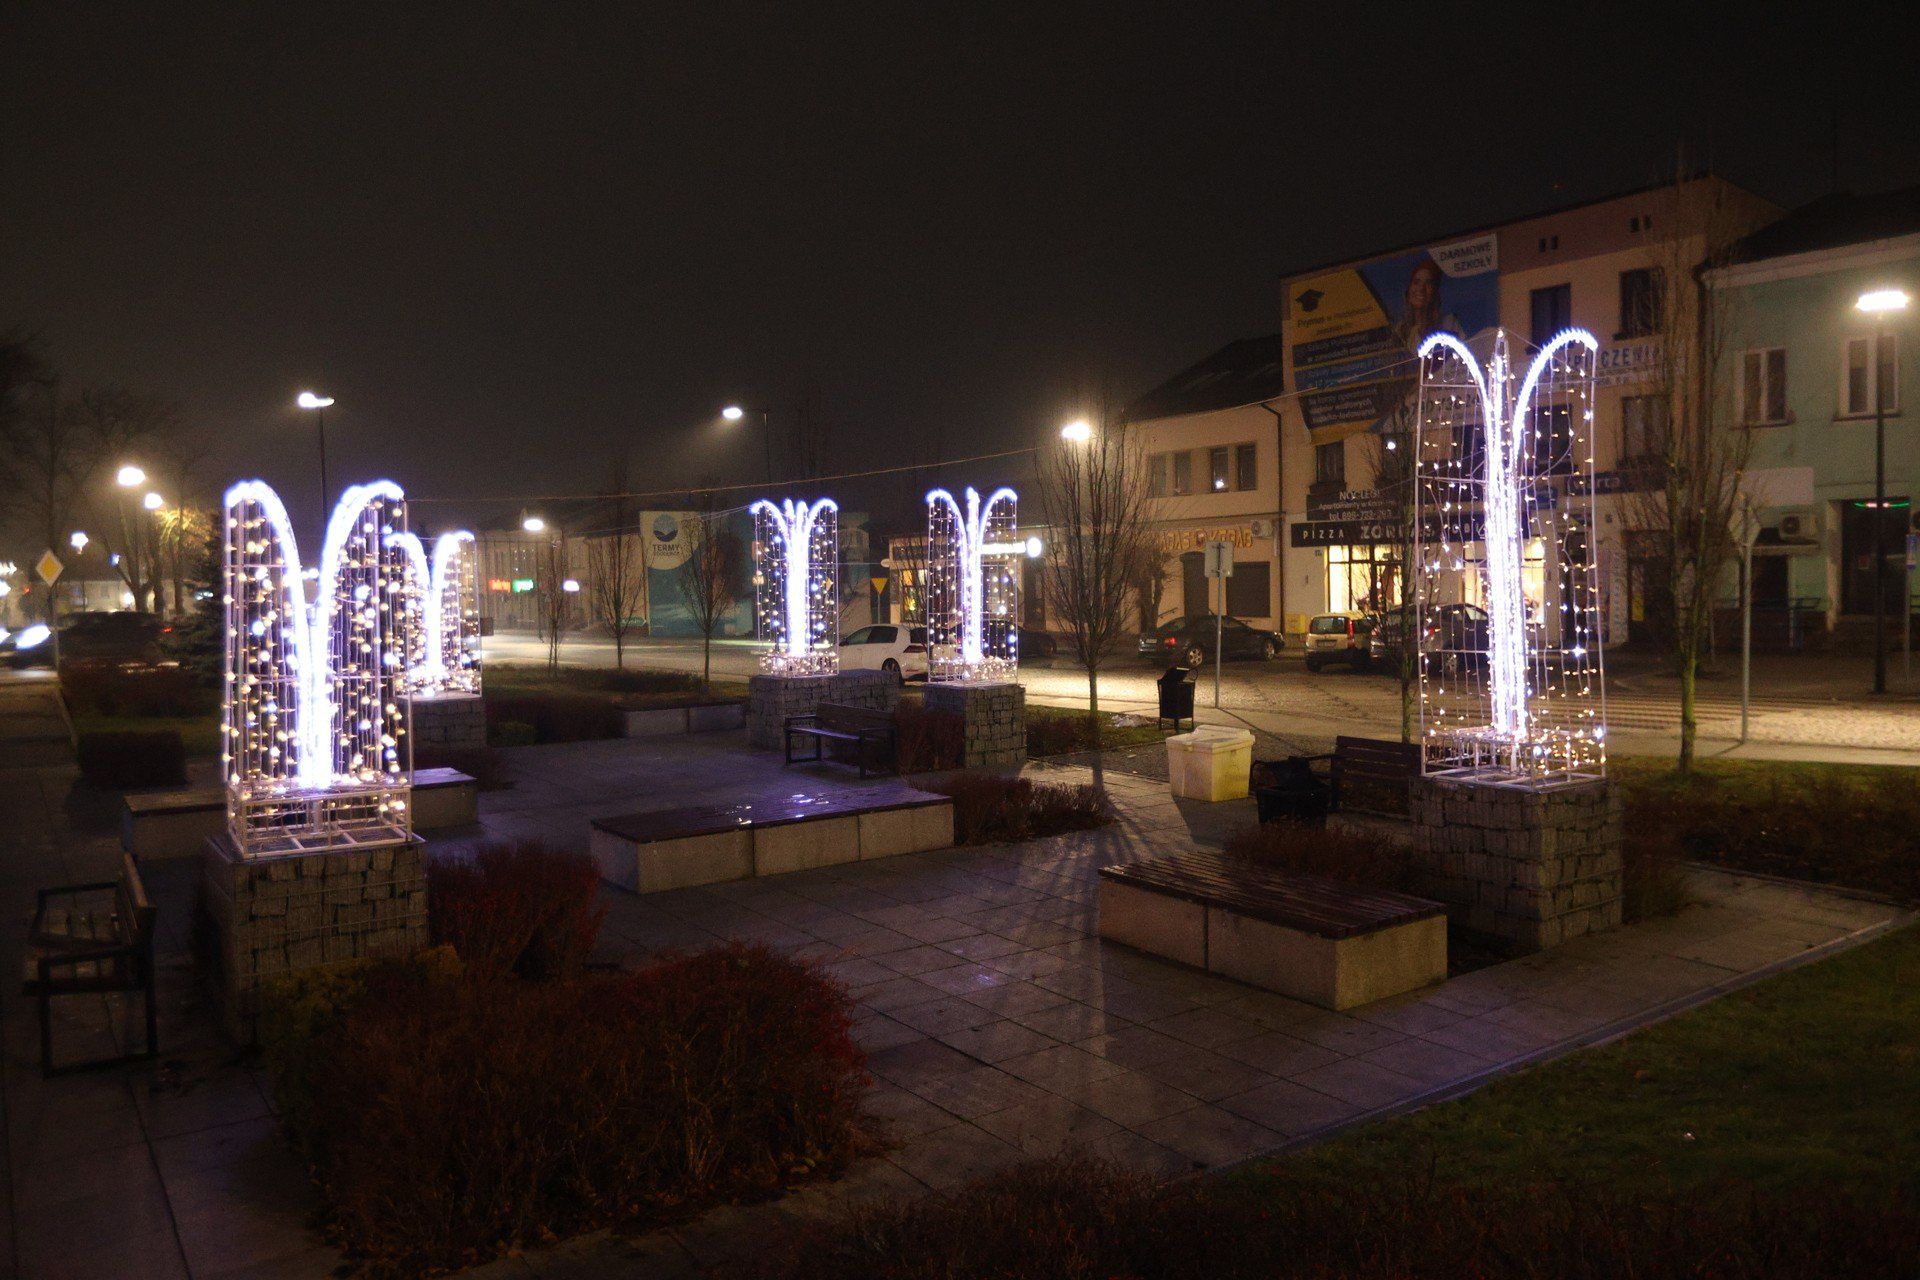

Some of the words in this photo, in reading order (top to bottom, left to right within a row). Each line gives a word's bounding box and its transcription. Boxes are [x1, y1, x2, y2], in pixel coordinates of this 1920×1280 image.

[1440, 242, 1491, 262] DARMOWE
[1303, 528, 1344, 540] PIZZA
[652, 544, 680, 552] TERMY
